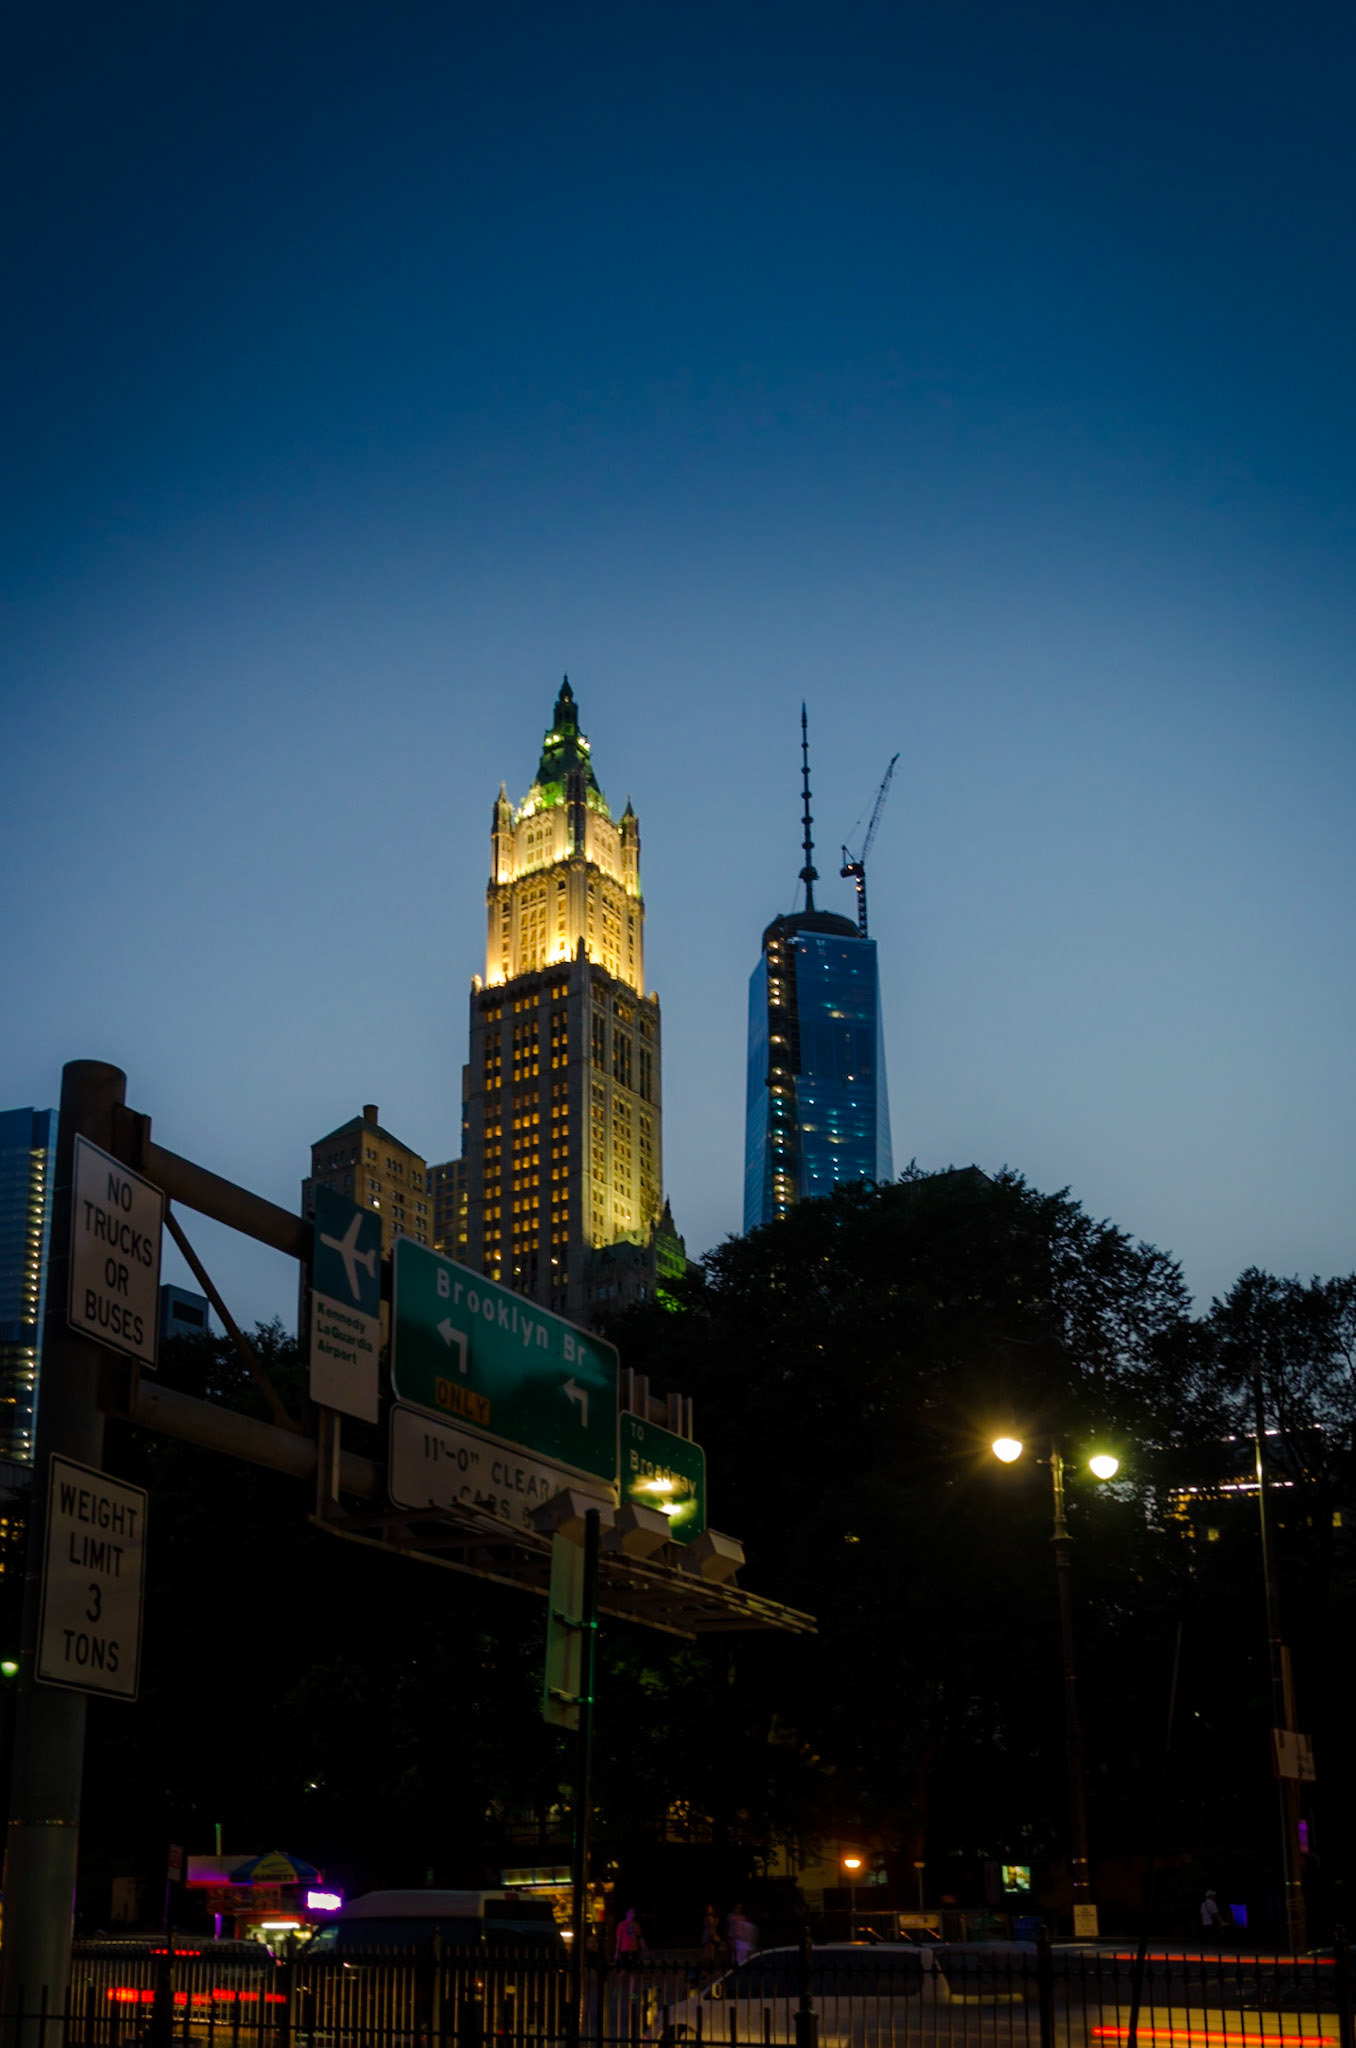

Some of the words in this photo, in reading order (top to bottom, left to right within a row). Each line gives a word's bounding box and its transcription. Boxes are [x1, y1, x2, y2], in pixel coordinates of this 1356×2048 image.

[108, 1172, 132, 1212] NO
[84, 1200, 153, 1267] TRUCKS
[105, 1258, 129, 1296] OR
[85, 1289, 144, 1345] BUSES
[317, 1302, 366, 1334] Kennedy
[317, 1320, 373, 1353] LaGuardia
[435, 1266, 550, 1350] Brooklyn
[562, 1333, 588, 1367] Br
[317, 1339, 357, 1365] Airport
[437, 1381, 490, 1421] ONLY
[630, 1421, 645, 1441] TO
[60, 1482, 137, 1538] WEIGHT
[69, 1532, 124, 1577] LIMIT
[86, 1583, 102, 1622] 3
[63, 1629, 119, 1672] TONS
